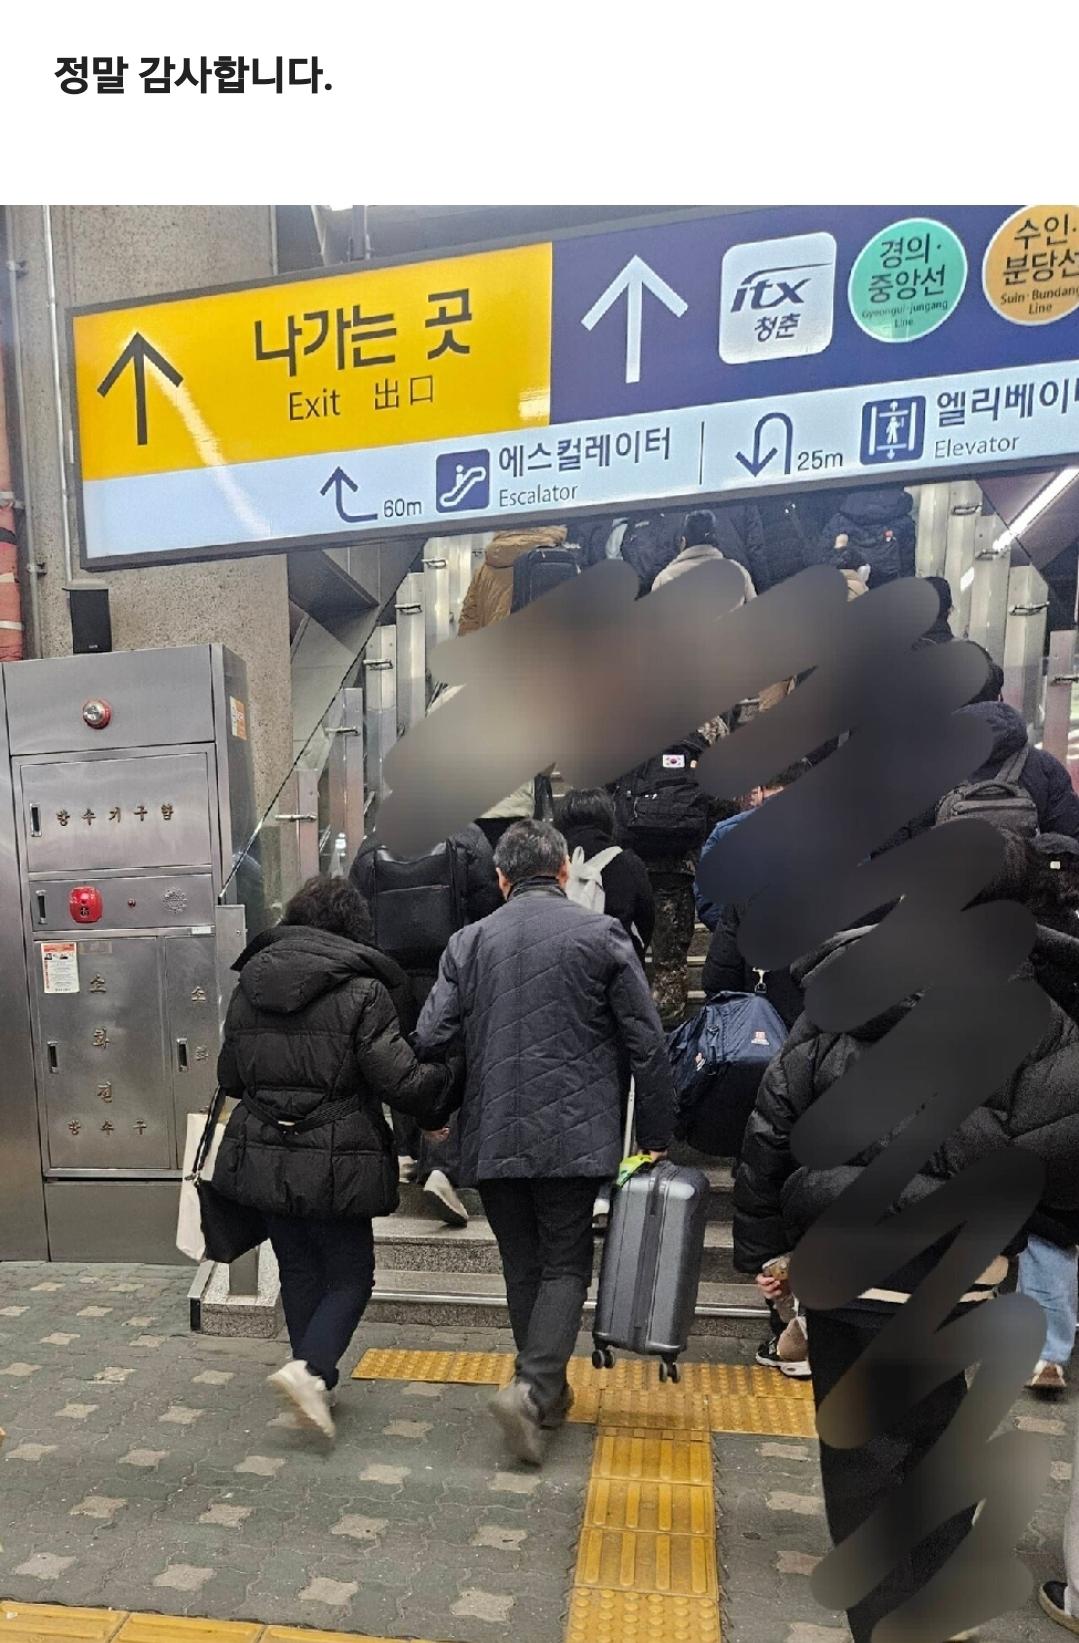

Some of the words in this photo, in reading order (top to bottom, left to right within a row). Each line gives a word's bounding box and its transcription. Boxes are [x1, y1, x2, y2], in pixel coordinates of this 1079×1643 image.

[868, 264, 945, 303] 중앙선
[894, 318, 914, 328] Line
[1028, 303, 1053, 315] Line
[254, 304, 397, 377] 나가는
[425, 289, 473, 359] 곳
[754, 312, 801, 342] 청춘
[288, 388, 341, 421] Exit
[374, 375, 434, 411] 出口
[936, 378, 1079, 428] 엘리베이
[499, 426, 670, 477] 에스컬레이터
[797, 449, 843, 471] 25m
[935, 436, 1019, 459] Elevator
[383, 497, 422, 519] 60m
[499, 484, 578, 507] Escalator
